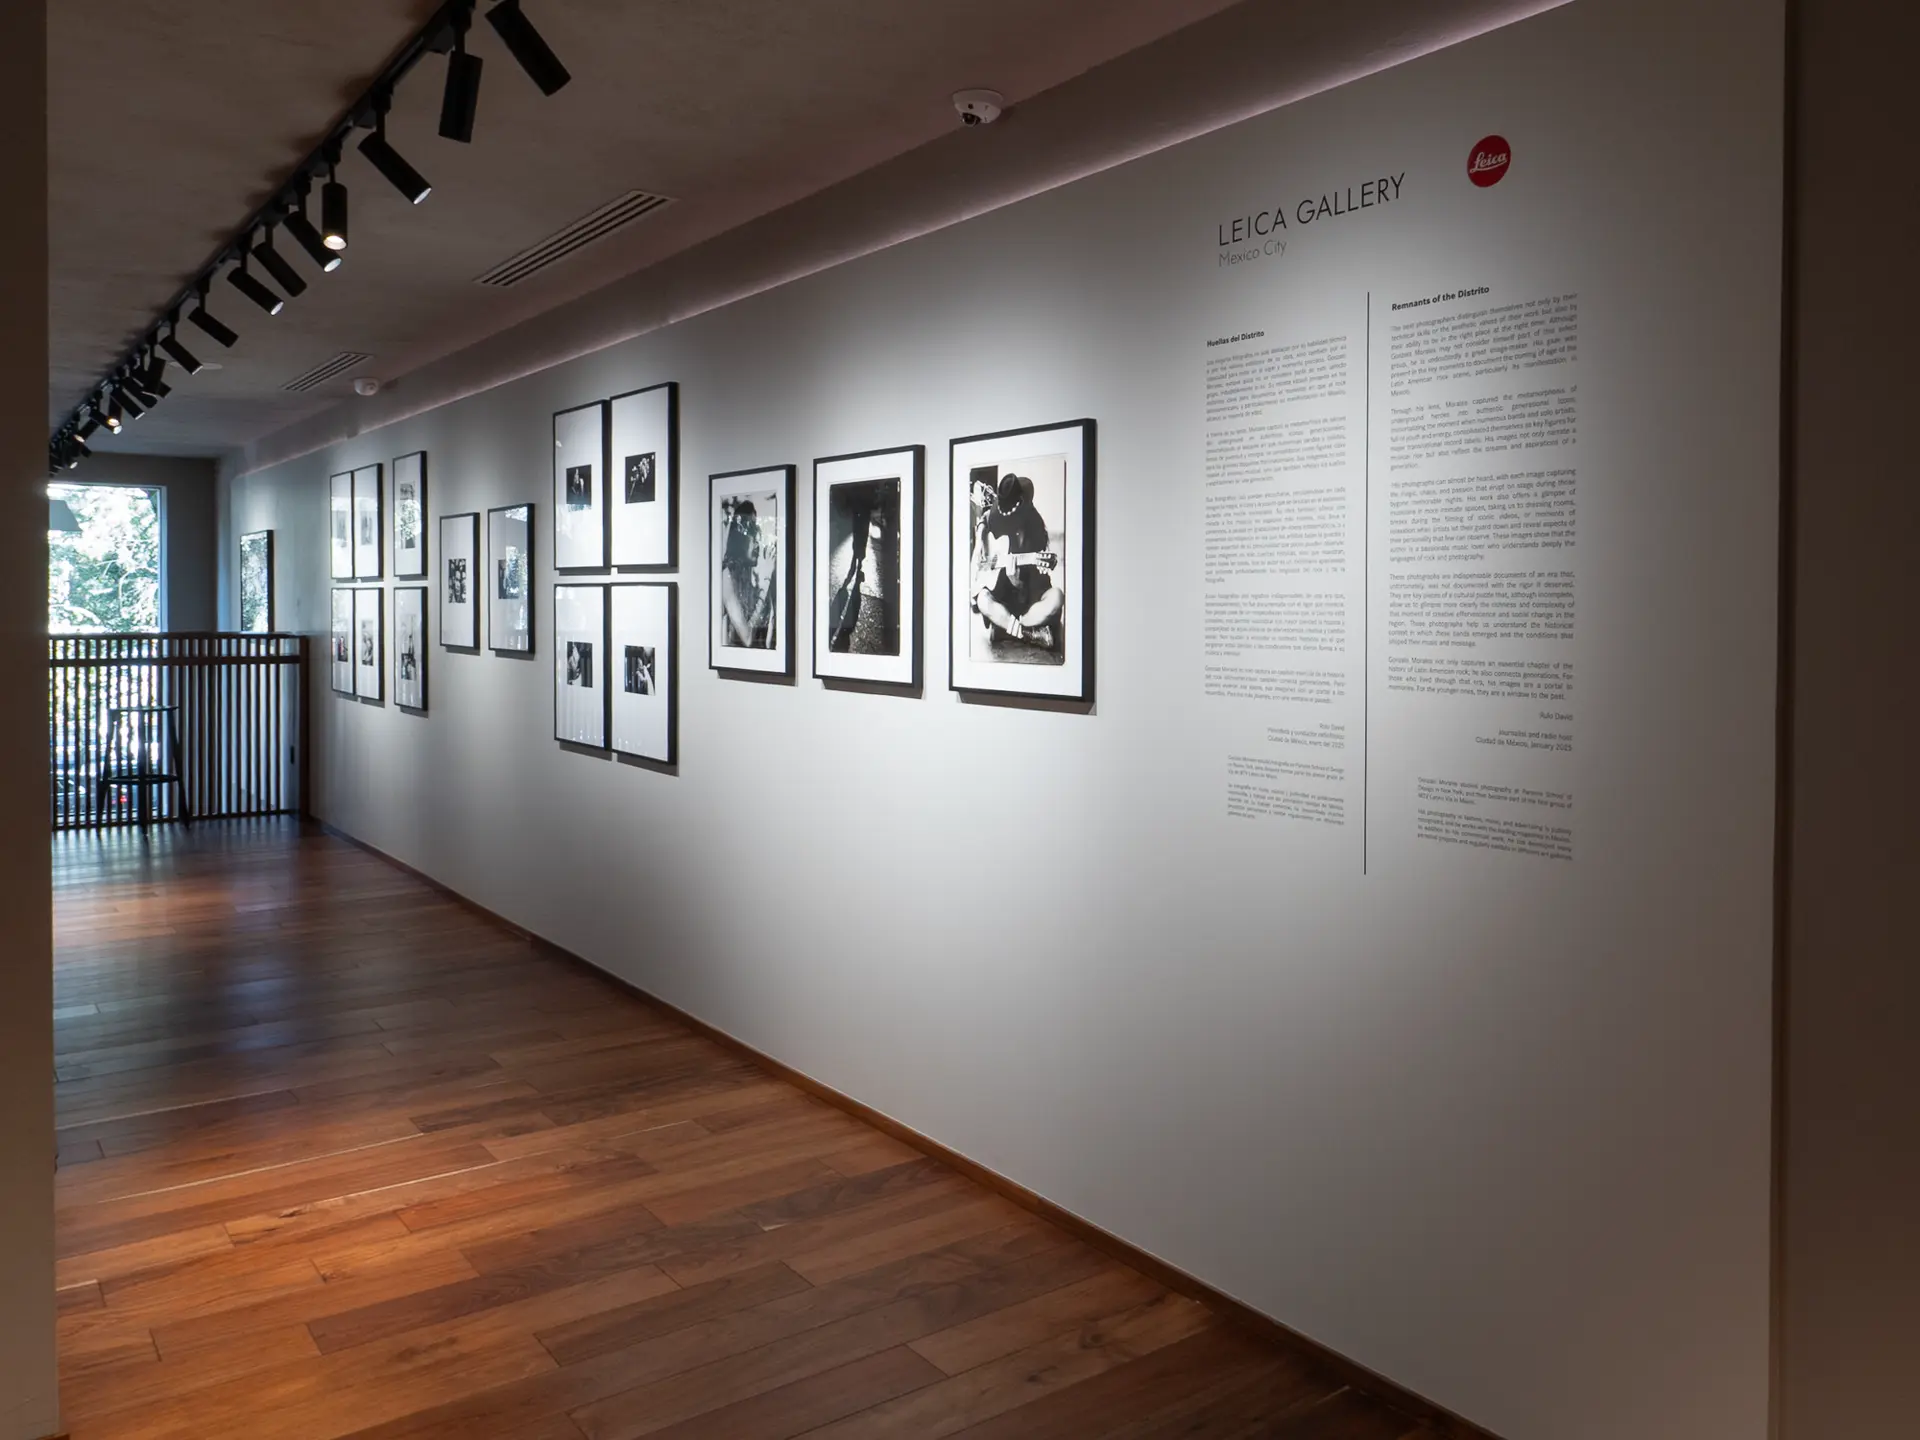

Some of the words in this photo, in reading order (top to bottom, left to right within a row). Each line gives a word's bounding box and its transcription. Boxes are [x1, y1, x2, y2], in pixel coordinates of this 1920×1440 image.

[1469, 152, 1508, 174] Leica
[1219, 207, 1287, 246] LEICA
[1296, 172, 1405, 224] GALLERY
[1219, 248, 1259, 267] Mexico
[1263, 239, 1287, 257] City
[1391, 296, 1430, 311] Remnants
[1432, 294, 1440, 303] of
[1442, 292, 1455, 301] the
[1458, 285, 1489, 298] Distrito
[1207, 337, 1229, 348] Huellas
[1241, 330, 1265, 341] Distrito
